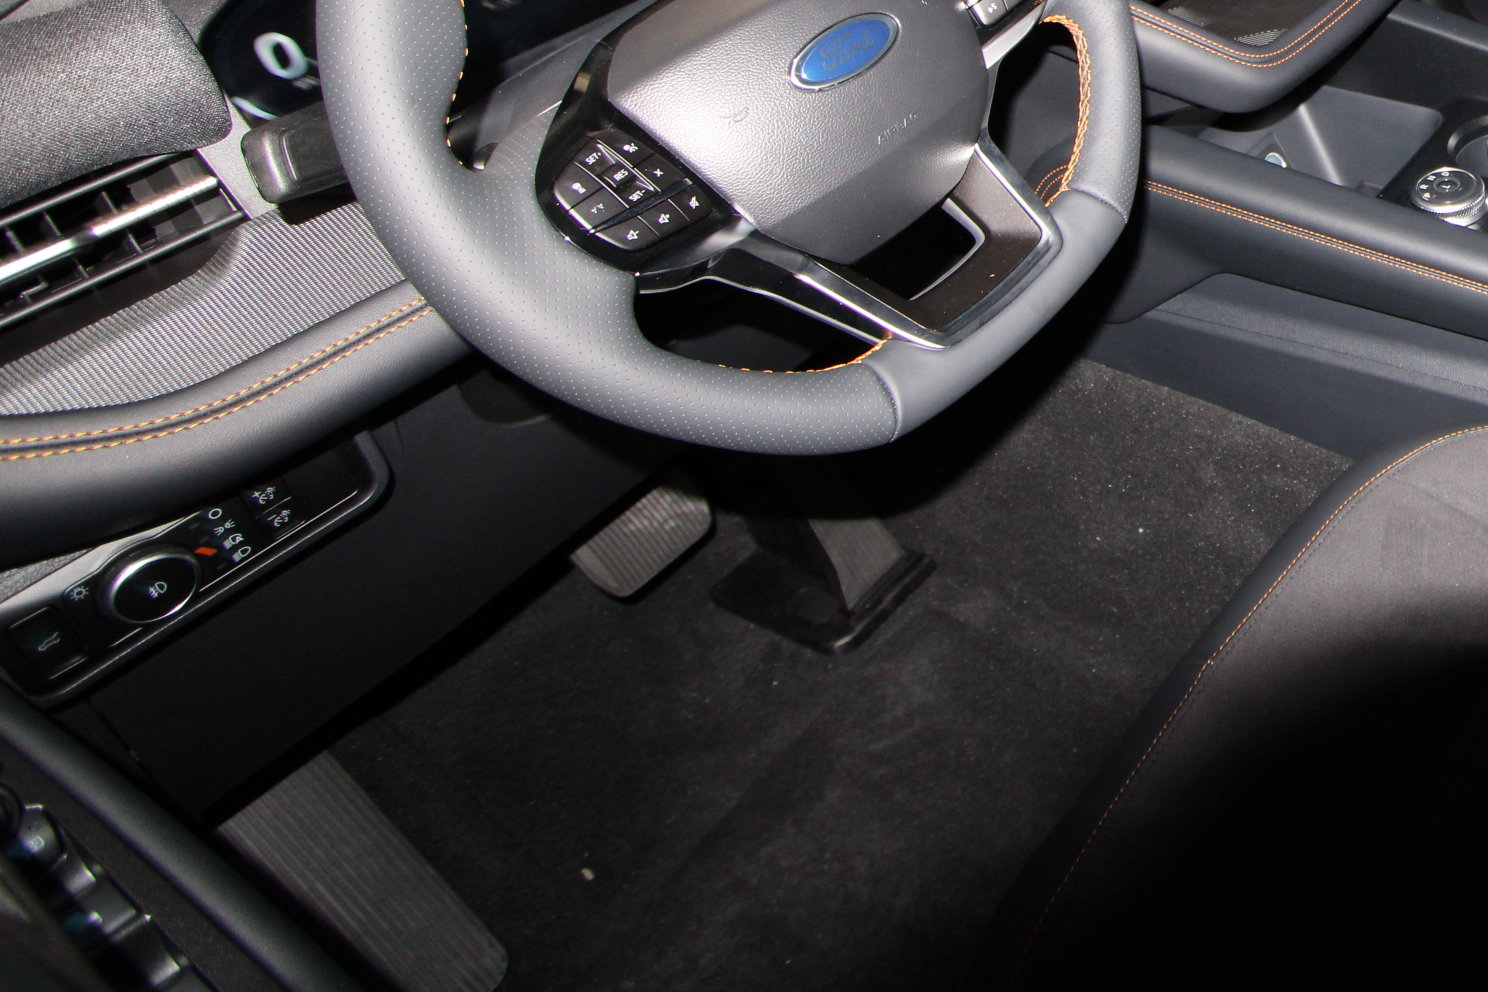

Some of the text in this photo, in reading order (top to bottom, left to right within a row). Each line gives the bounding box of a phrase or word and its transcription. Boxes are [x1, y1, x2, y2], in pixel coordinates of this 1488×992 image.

[253, 31, 308, 80] 0
[821, 30, 873, 72] Ford
[613, 169, 629, 181] RES
